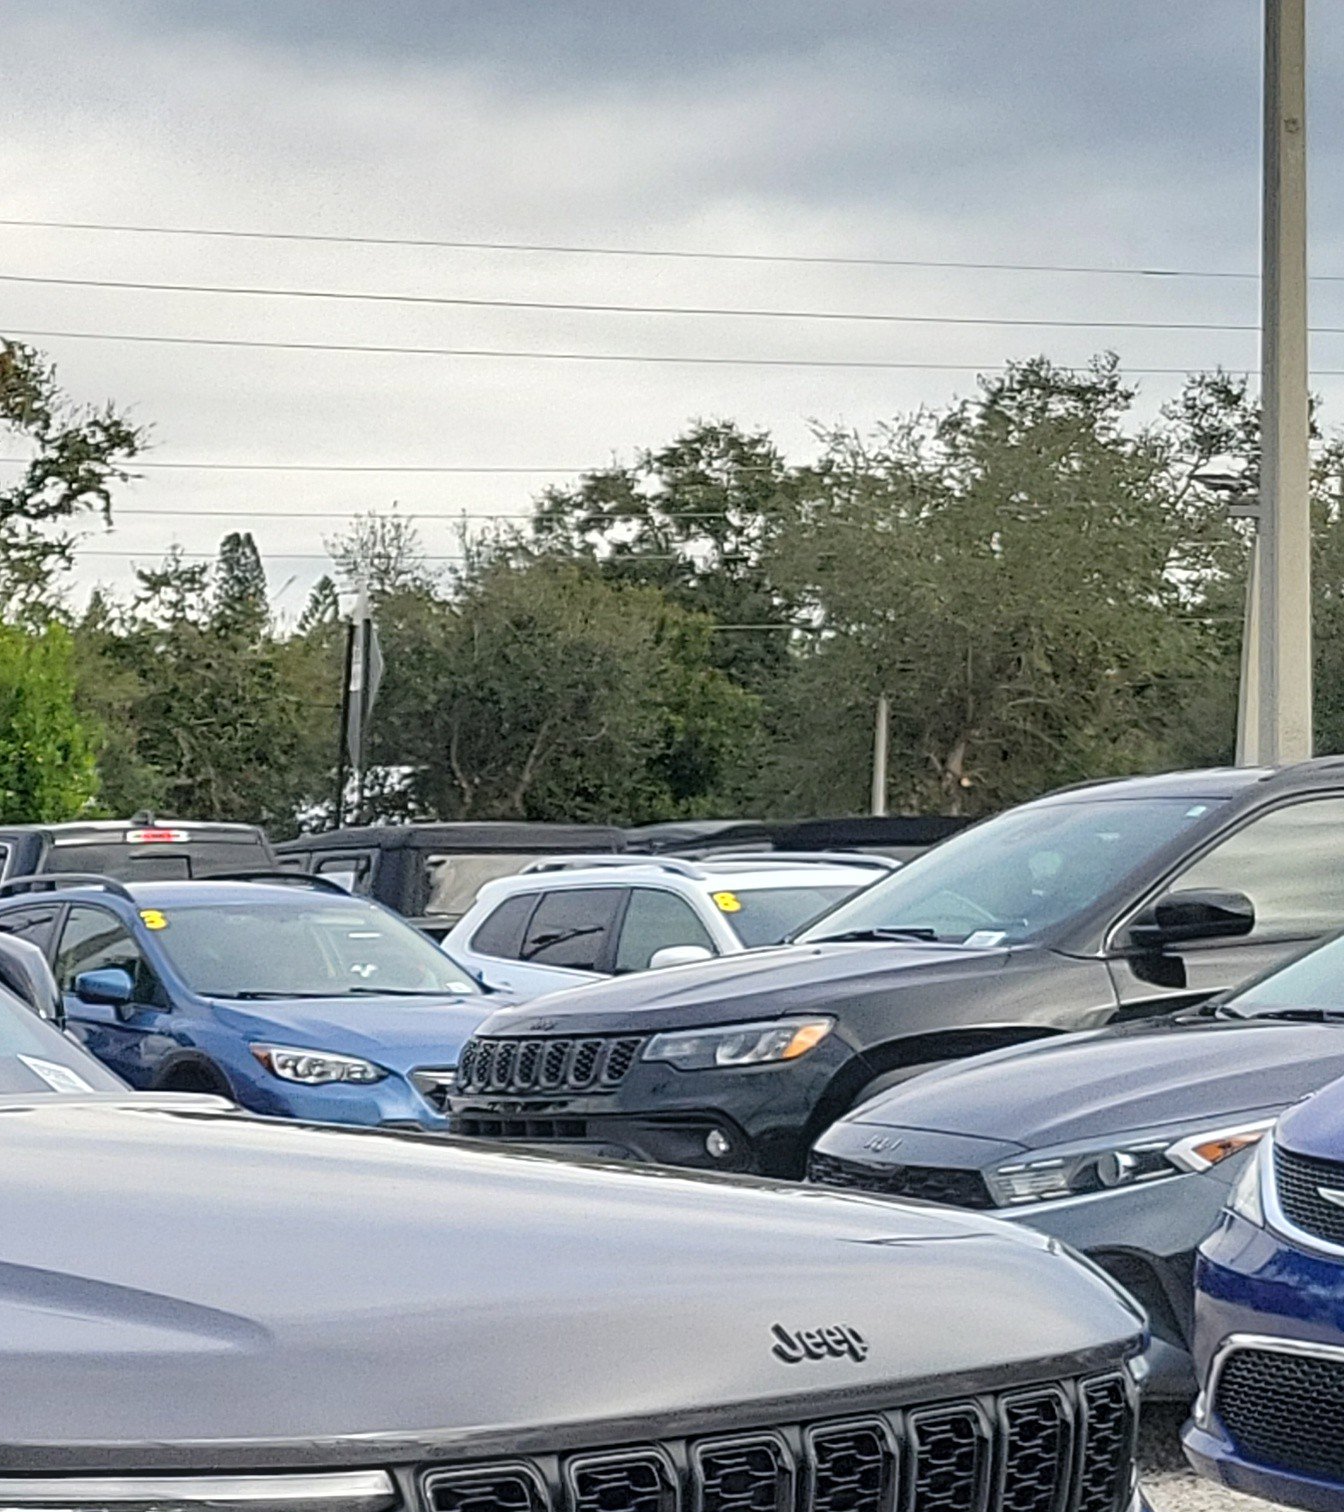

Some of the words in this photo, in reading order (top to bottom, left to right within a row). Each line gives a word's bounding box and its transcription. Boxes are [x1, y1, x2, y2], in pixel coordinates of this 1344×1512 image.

[713, 891, 742, 912] 8
[139, 910, 167, 929] 3
[771, 1323, 868, 1364] Jeep
